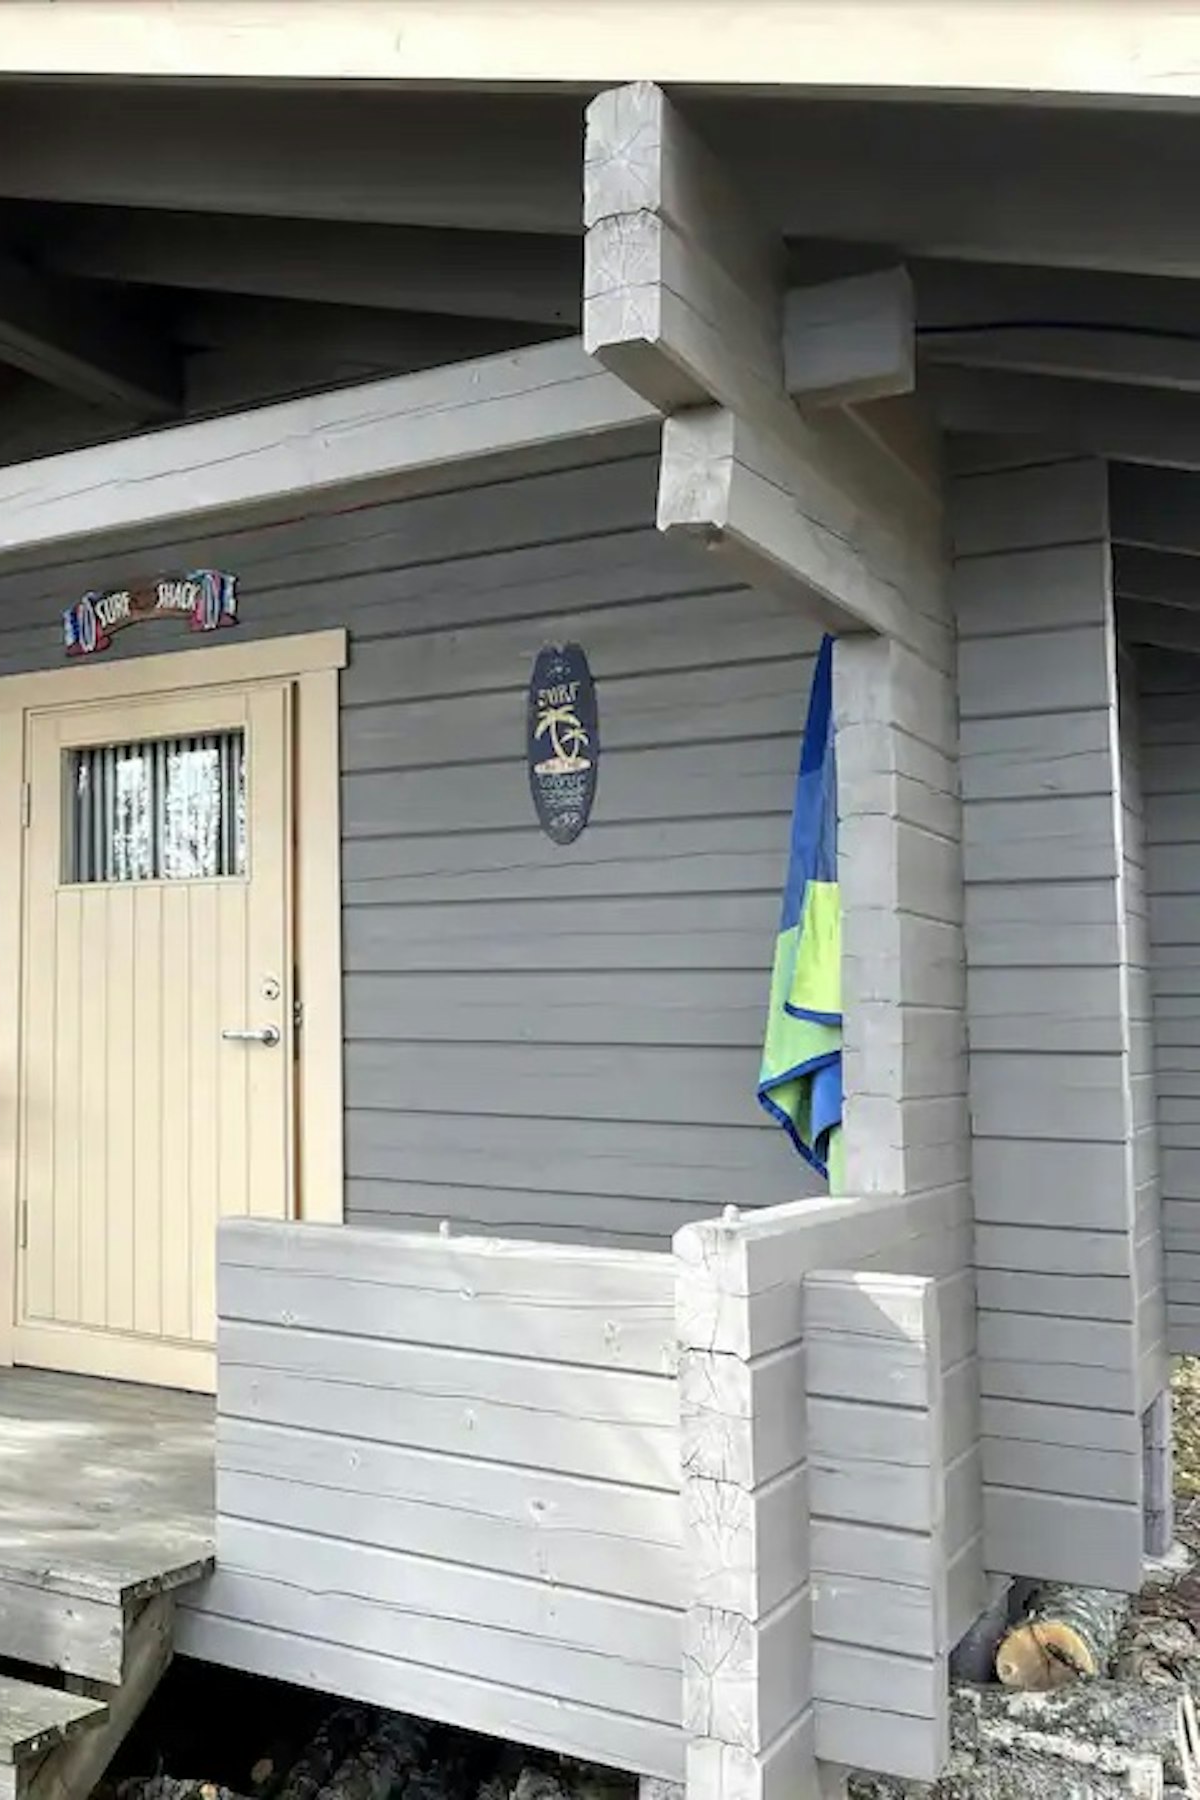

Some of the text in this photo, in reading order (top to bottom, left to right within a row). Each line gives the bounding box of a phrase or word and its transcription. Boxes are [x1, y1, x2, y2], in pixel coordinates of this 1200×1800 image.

[96, 583, 200, 627] SURF SHACK
[538, 682, 581, 706] SURF
